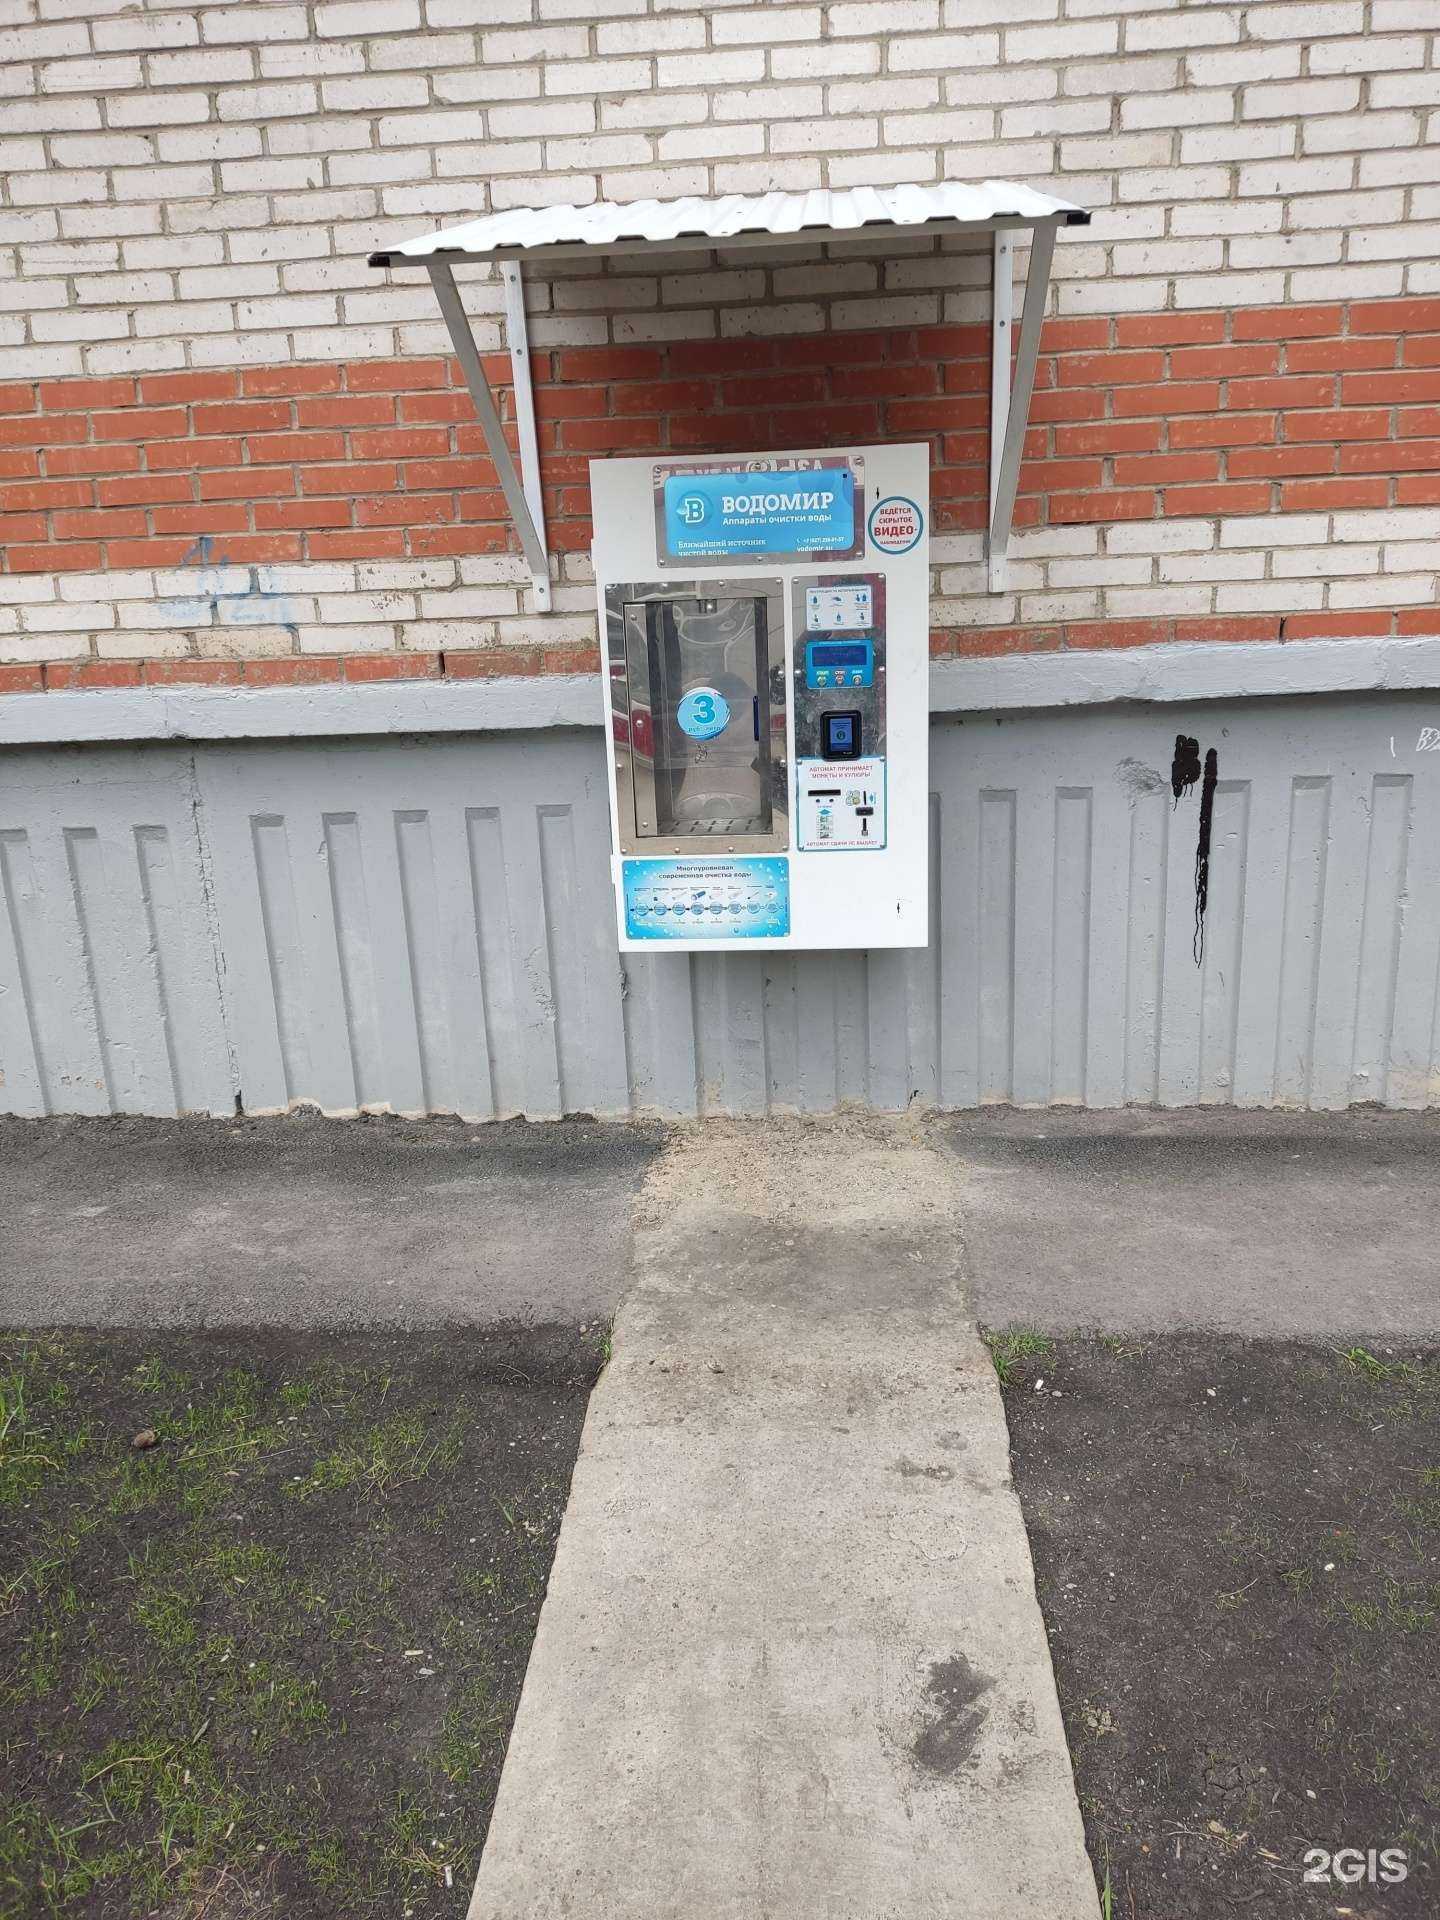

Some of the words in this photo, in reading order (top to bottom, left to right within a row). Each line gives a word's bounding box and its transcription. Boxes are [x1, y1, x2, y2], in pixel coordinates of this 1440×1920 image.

[722, 492, 834, 515] ВОДОМИР
[722, 517, 767, 527] Аппараты
[768, 515, 806, 524] очистки
[808, 514, 832, 523] воды
[693, 694, 716, 724] 3
